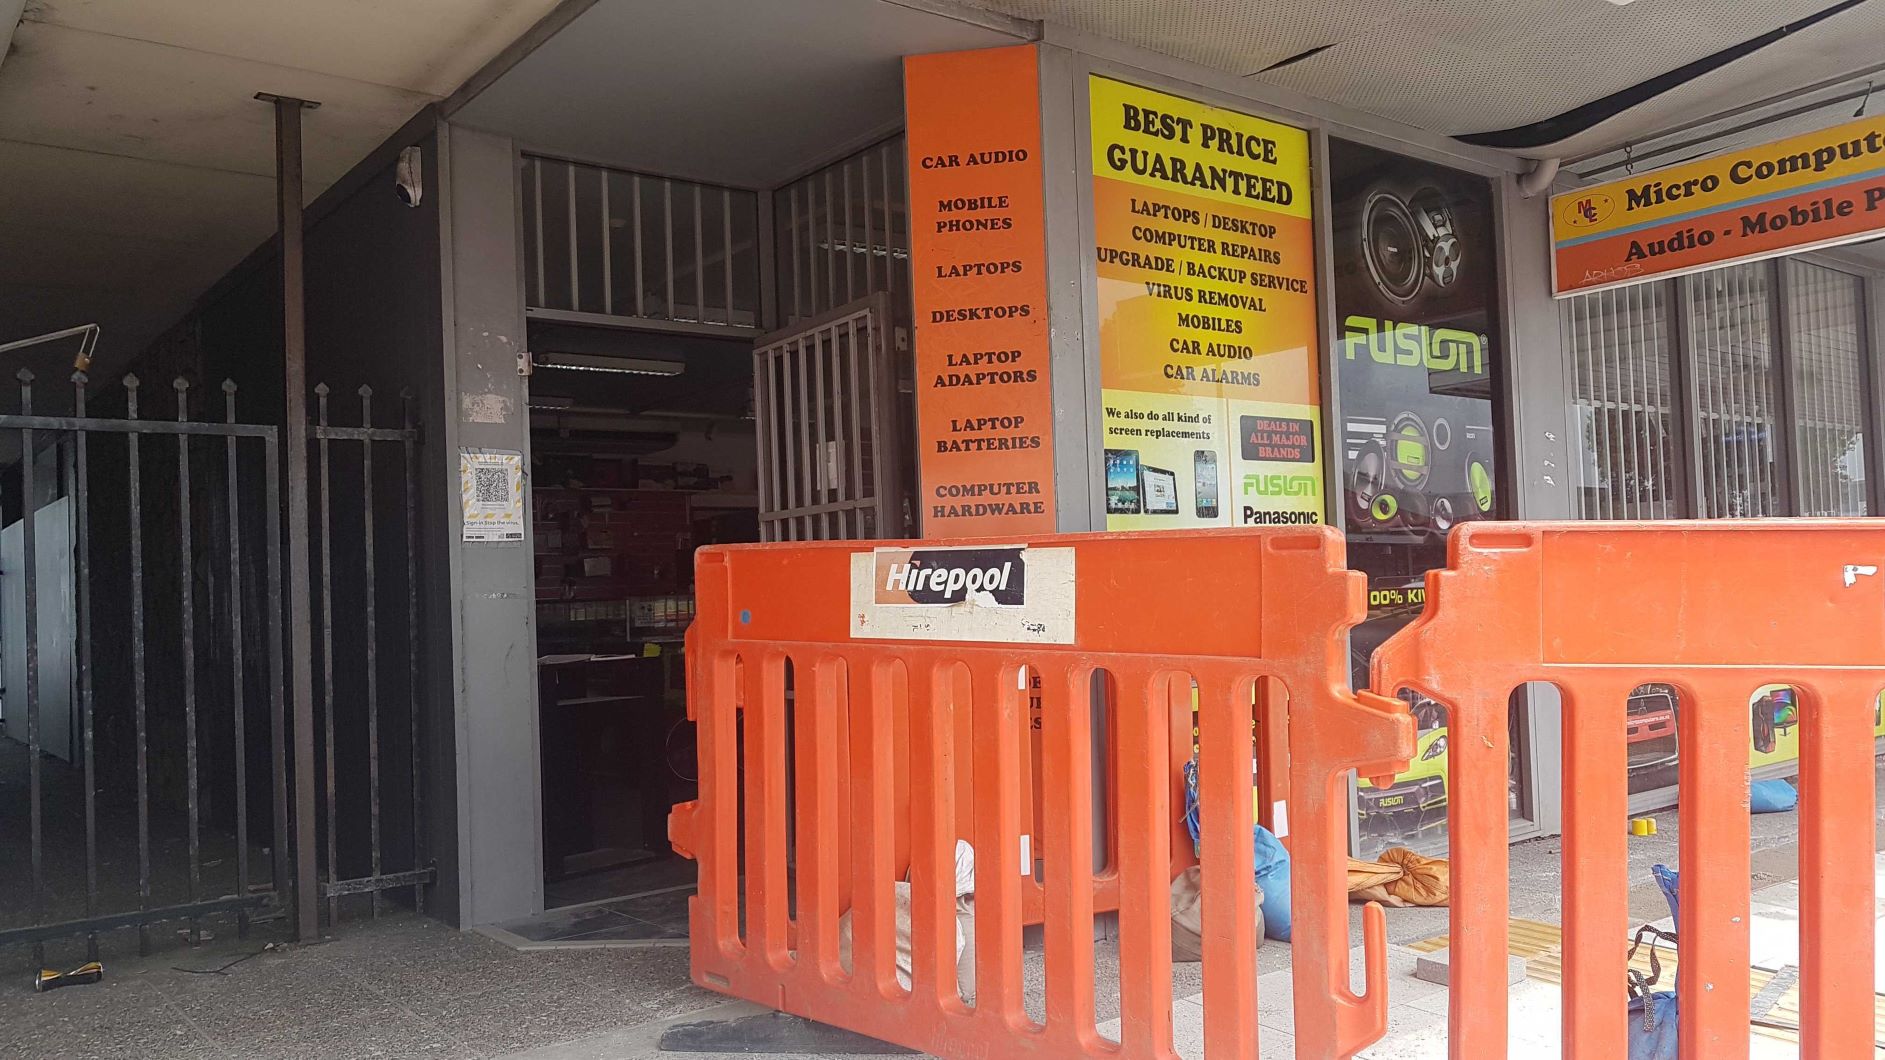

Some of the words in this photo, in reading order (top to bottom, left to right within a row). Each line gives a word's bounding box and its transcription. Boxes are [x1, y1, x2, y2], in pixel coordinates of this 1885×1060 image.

[1122, 103, 1193, 144] BEST
[1200, 122, 1278, 165] PRICE
[921, 154, 961, 169] CAR
[965, 149, 1028, 166] AUDIO
[1106, 143, 1293, 206] GUARANTEED
[1624, 173, 1720, 211] Micro
[1729, 130, 1885, 184] Comput
[938, 195, 1010, 213] MOBILE
[935, 217, 1013, 233] PHONES
[1130, 198, 1200, 225] LAPTOPS
[1204, 212, 1208, 228] /
[1211, 213, 1277, 239] DESKTOP
[1624, 227, 1716, 263] Audio
[1722, 228, 1732, 238] -
[1740, 197, 1855, 237] Mobile
[1131, 225, 1217, 254] COMPUTER
[1220, 241, 1281, 265] REPAIRS
[935, 260, 1022, 278] LAPTOPS
[1096, 246, 1175, 274] UPGRADE
[1178, 259, 1183, 276] /
[1186, 261, 1247, 285] BACKUP
[1250, 271, 1308, 294] SERVICE
[1145, 281, 1193, 302] VIRUS
[1197, 288, 1266, 312] REMOVAL
[931, 304, 1030, 323] DESKTOPS
[1177, 312, 1243, 334] MOBILES
[1169, 337, 1201, 355] CAR
[1205, 342, 1253, 360] AUDIO
[946, 350, 1022, 367] LAPTOP
[933, 369, 1037, 388] ADAPTORS
[1163, 363, 1196, 381] CAR
[1200, 367, 1261, 387] ALARMS
[951, 415, 1025, 432] LAPTOP
[1105, 406, 1121, 419] We
[1124, 408, 1144, 420] also
[1147, 410, 1159, 421] do
[1161, 411, 1174, 422] all
[1177, 412, 1200, 424] kind
[1202, 414, 1212, 424] of
[1108, 426, 1142, 436] screen
[1144, 427, 1211, 440] replacements
[1256, 420, 1287, 431] DEALS
[1289, 421, 1300, 432] IN
[936, 435, 1041, 453] BATTERIES
[1249, 431, 1269, 443] ALL
[1271, 433, 1307, 446] MAJOR
[1258, 446, 1300, 459] BRANDS
[935, 481, 1041, 498] COMPUTER
[932, 501, 1045, 518] HARDWARE
[1243, 505, 1318, 525] Panasonic
[885, 561, 1012, 599] Hirepool
[1370, 589, 1404, 605] 00%
